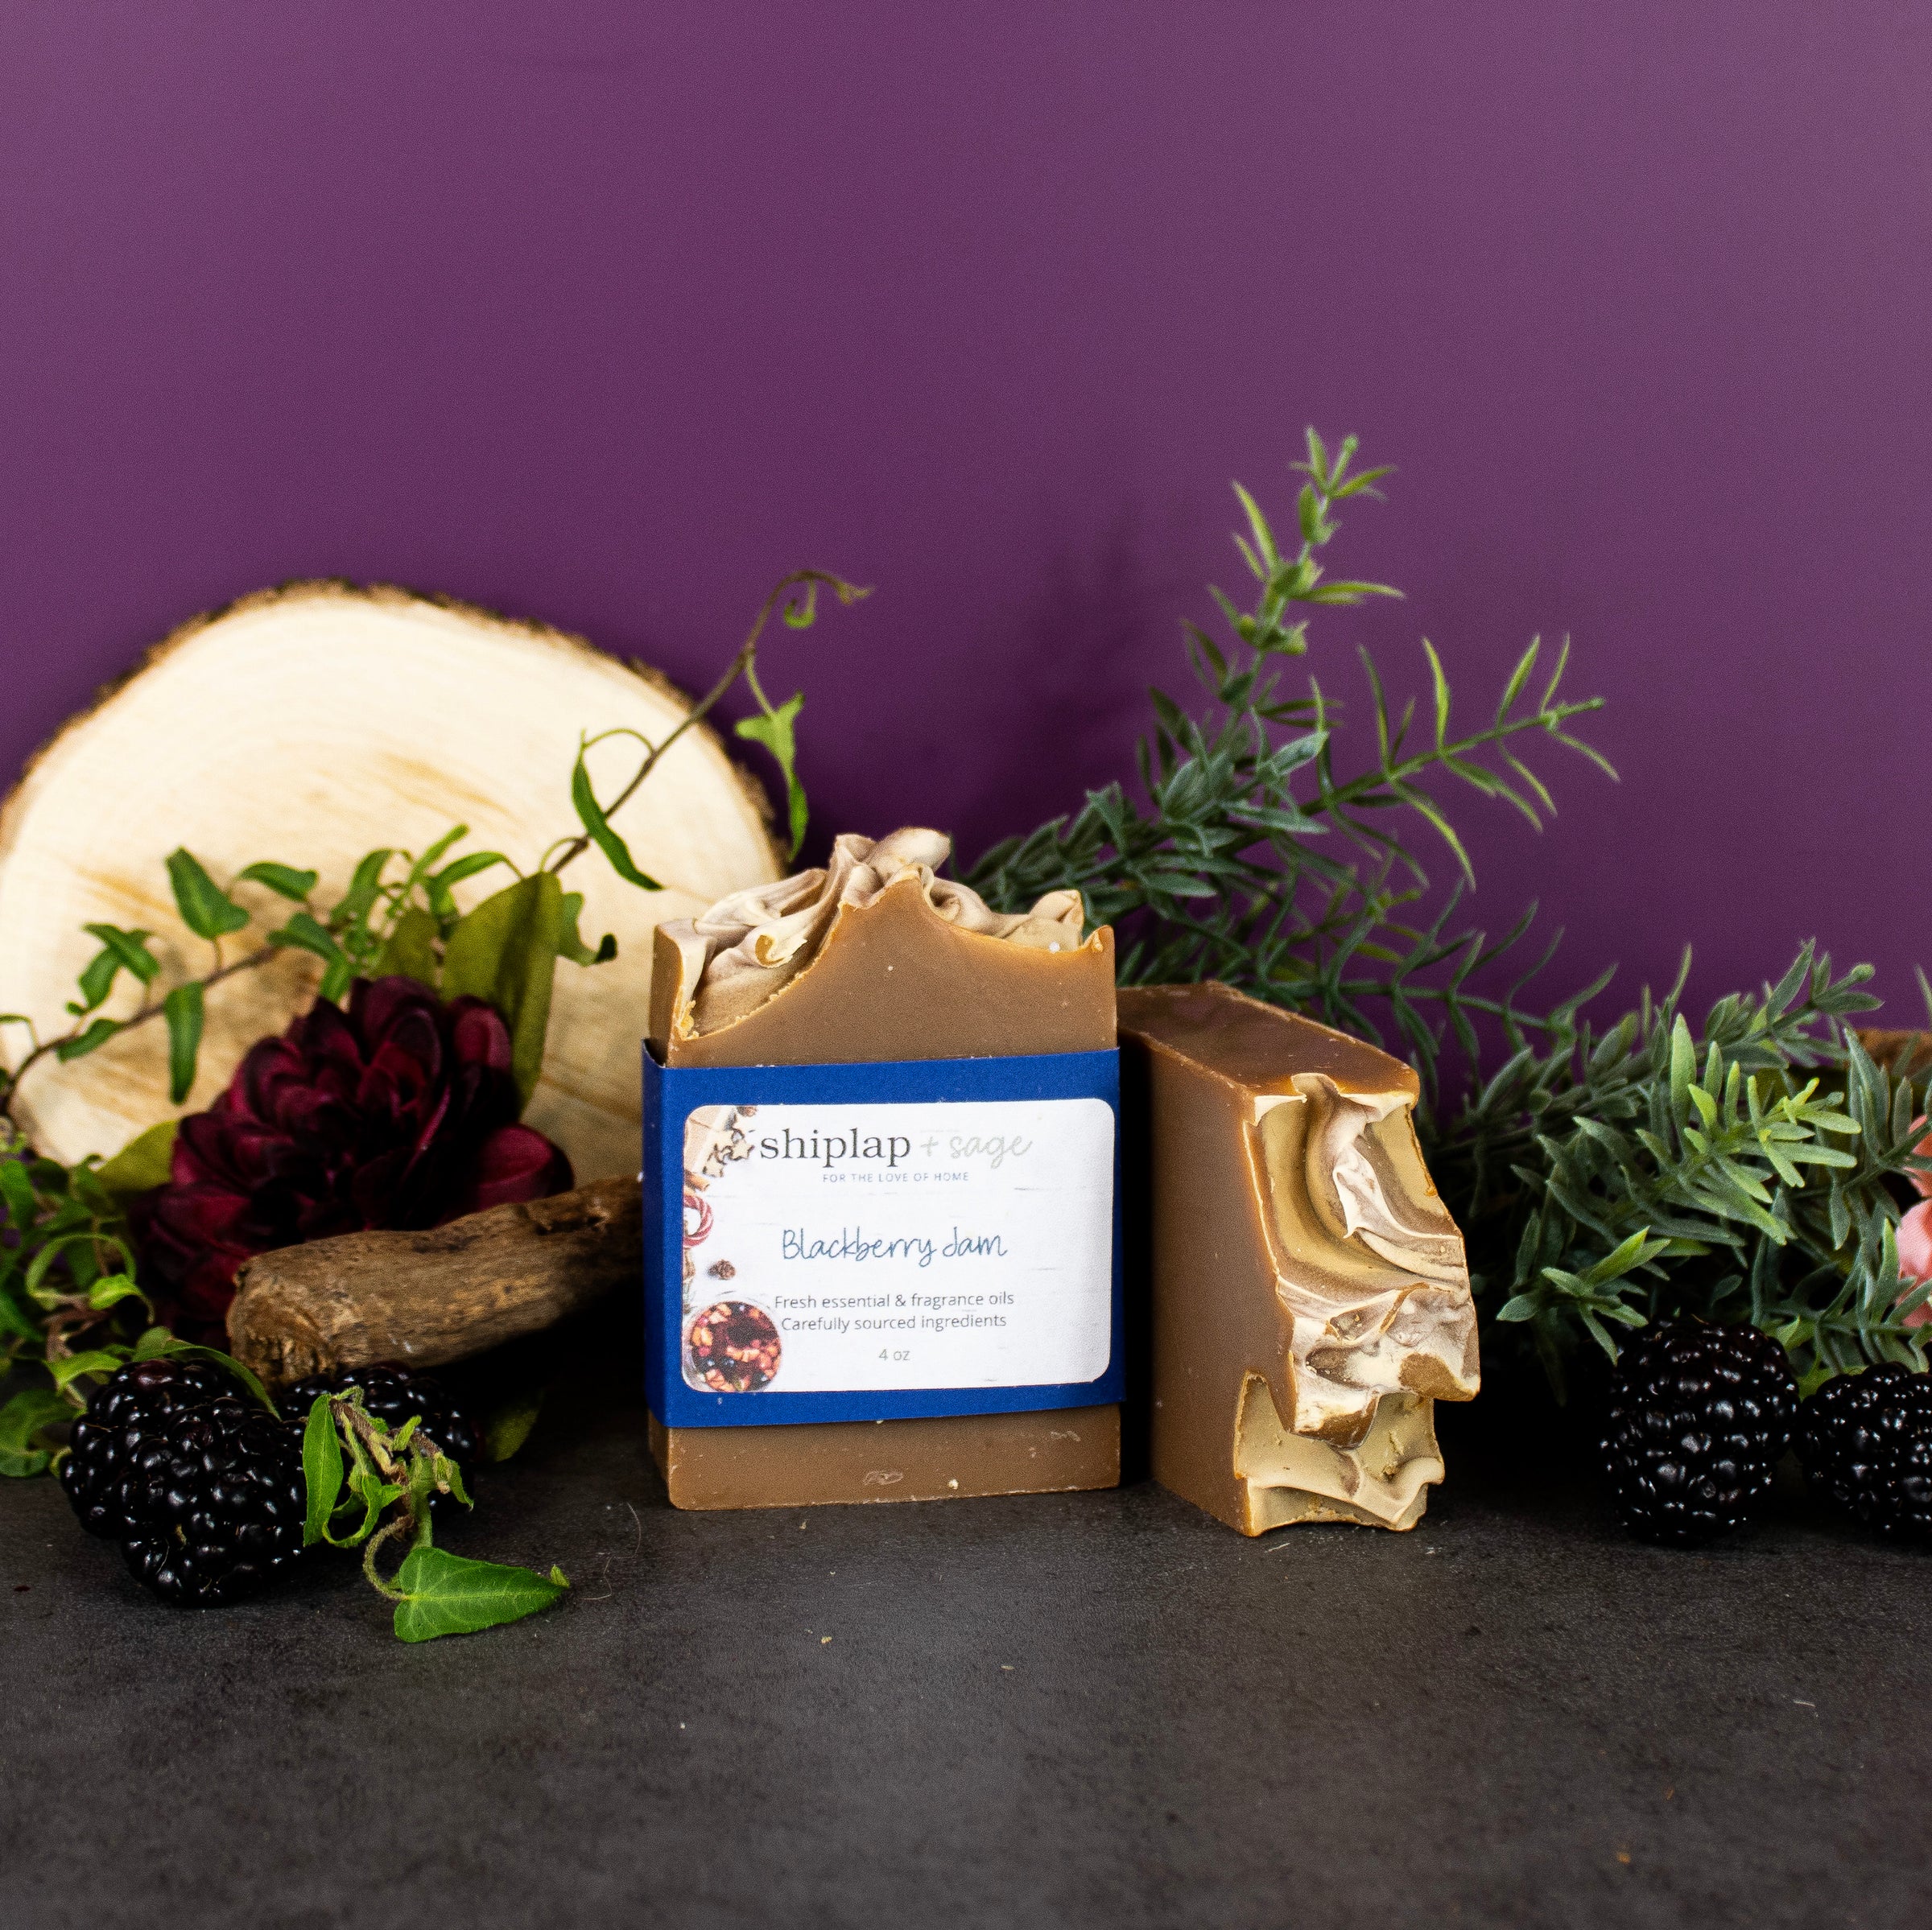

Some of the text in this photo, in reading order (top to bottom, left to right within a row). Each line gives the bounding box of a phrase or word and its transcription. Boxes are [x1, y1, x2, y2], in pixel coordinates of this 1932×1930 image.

[760, 1128, 911, 1168] shiplap
[949, 1136, 1033, 1169] sage
[823, 1172, 968, 1183] FOR THE LOVE OF HOME
[782, 1226, 1008, 1268] Blackberry Jam
[775, 1291, 1014, 1310] Fresh essential & fragrance oils
[782, 1314, 1006, 1334] Carefully sourced ingredients
[878, 1349, 910, 1361] 4 oz
